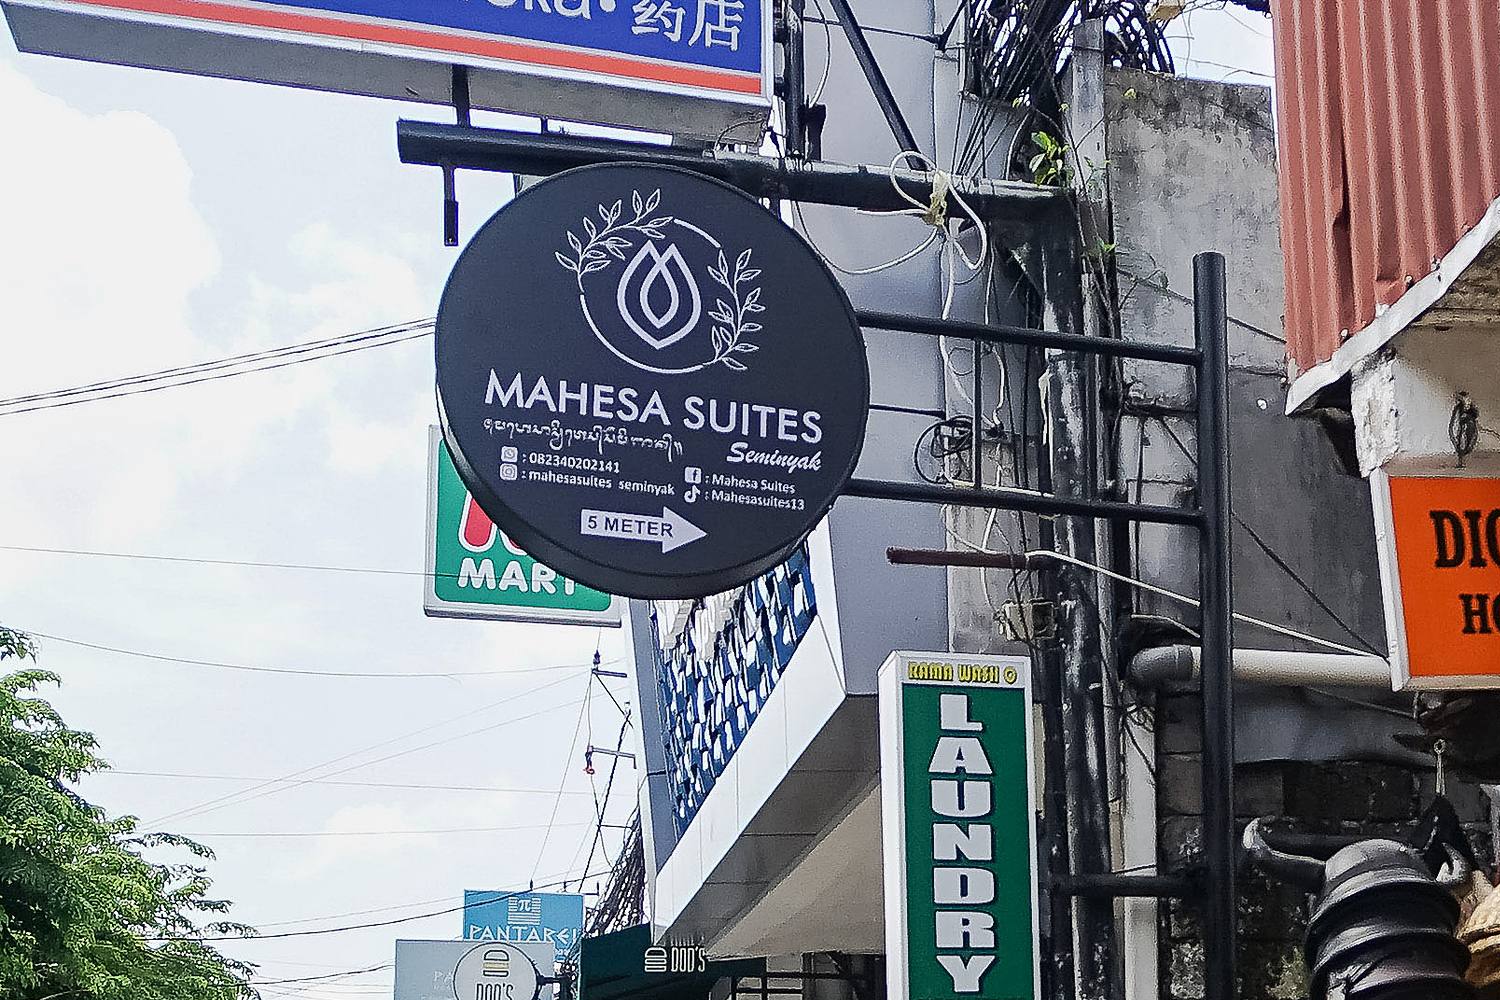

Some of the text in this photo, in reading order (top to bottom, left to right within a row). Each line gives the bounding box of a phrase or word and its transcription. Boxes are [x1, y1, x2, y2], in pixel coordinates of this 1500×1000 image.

[485, 368, 671, 426] MAHESA
[683, 395, 823, 444] SUITES
[529, 452, 620, 474] 082340202141
[726, 441, 822, 474] Seminyak
[528, 470, 676, 496] mahesasuites seminyak
[712, 473, 796, 494] Mahesa Suites
[711, 489, 806, 511] Mahesasuites13
[588, 515, 674, 539] 5 METER
[928, 693, 997, 993] LAUNDRY
